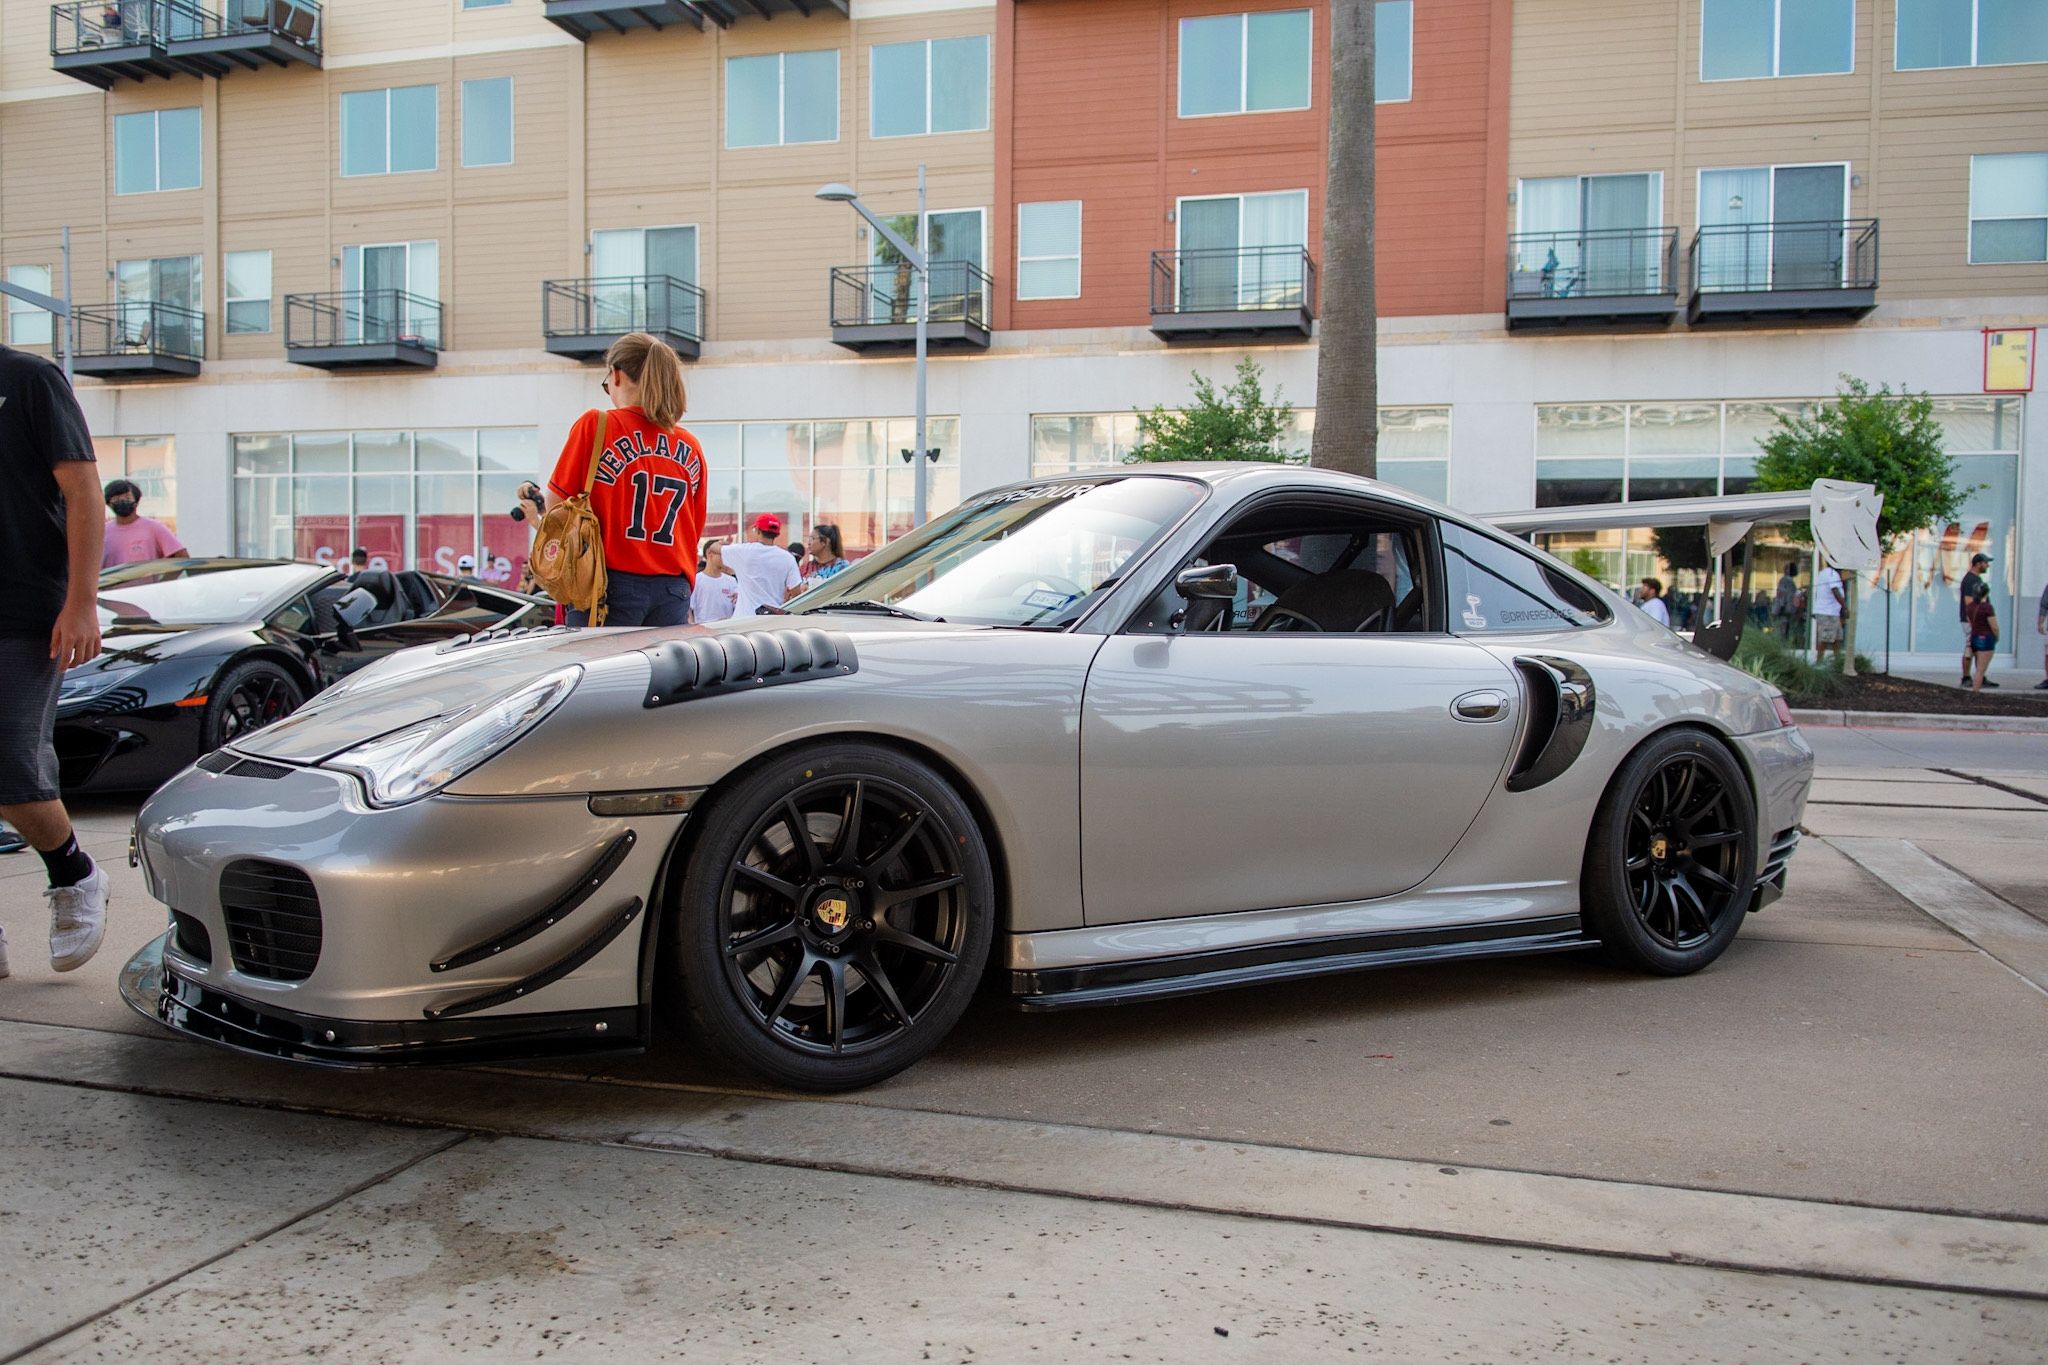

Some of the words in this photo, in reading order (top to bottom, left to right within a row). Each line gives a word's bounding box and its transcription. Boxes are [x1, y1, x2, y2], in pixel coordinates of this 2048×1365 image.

[595, 431, 700, 490] VERLAND
[626, 470, 688, 546] 17
[434, 546, 513, 582] Sle
